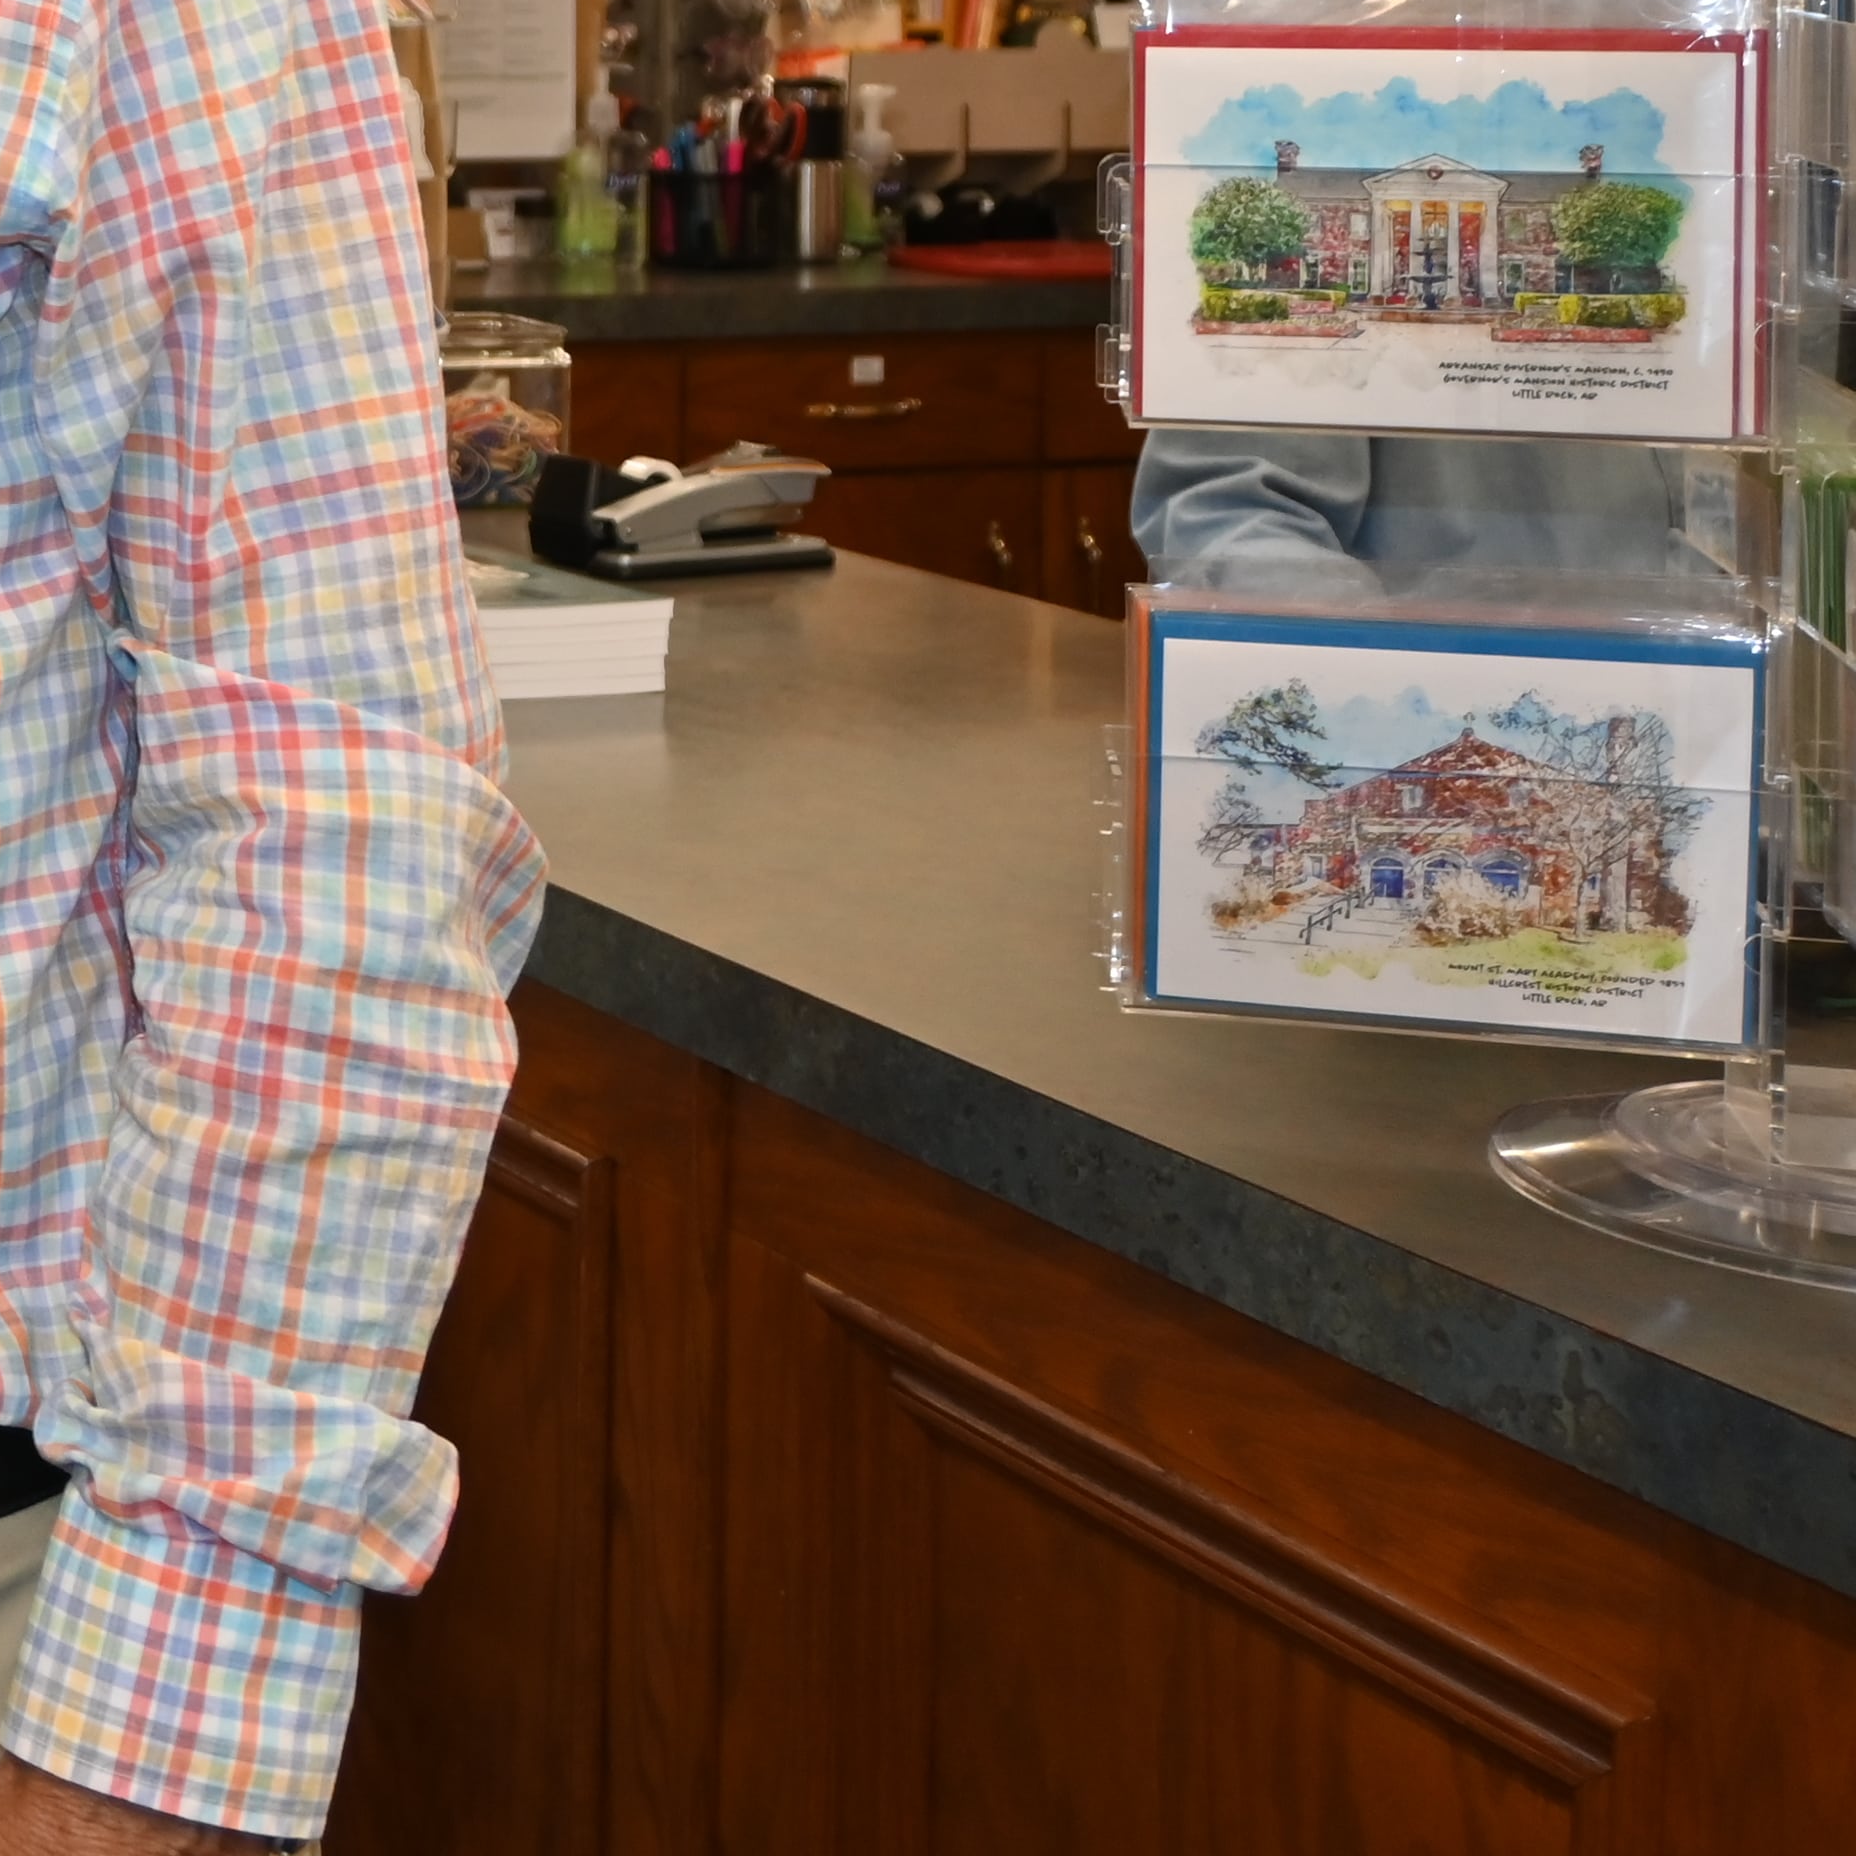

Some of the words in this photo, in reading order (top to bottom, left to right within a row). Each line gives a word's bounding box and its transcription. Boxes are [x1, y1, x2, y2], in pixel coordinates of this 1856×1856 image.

[1438, 361, 1501, 371] ARKANSAS
[1504, 362, 1572, 373] GOVERNOR'S
[1574, 366, 1631, 377] MANSION,
[1443, 373, 1510, 385] GOVERNOR'S
[1513, 377, 1566, 386] MANSION
[1569, 378, 1617, 388] HISTORIC
[1620, 380, 1670, 391] DISTRICT
[1511, 389, 1541, 400] LITTLE
[1545, 391, 1578, 401] ROCK,
[1580, 392, 1598, 400] AR
[1447, 962, 1484, 974] MOUNT
[1487, 965, 1502, 976] ST.
[1506, 967, 1538, 978] MARY
[1540, 969, 1598, 984] ACADEMY,
[1600, 974, 1655, 986] FOUNDED
[1487, 978, 1541, 991] HILLCREST
[1544, 982, 1592, 994] HISTORIC
[1595, 986, 1643, 999] DISTRICT
[1522, 993, 1551, 1005] LITTLE
[1554, 996, 1587, 1007] ROCK,
[1590, 998, 1607, 1008] AR
